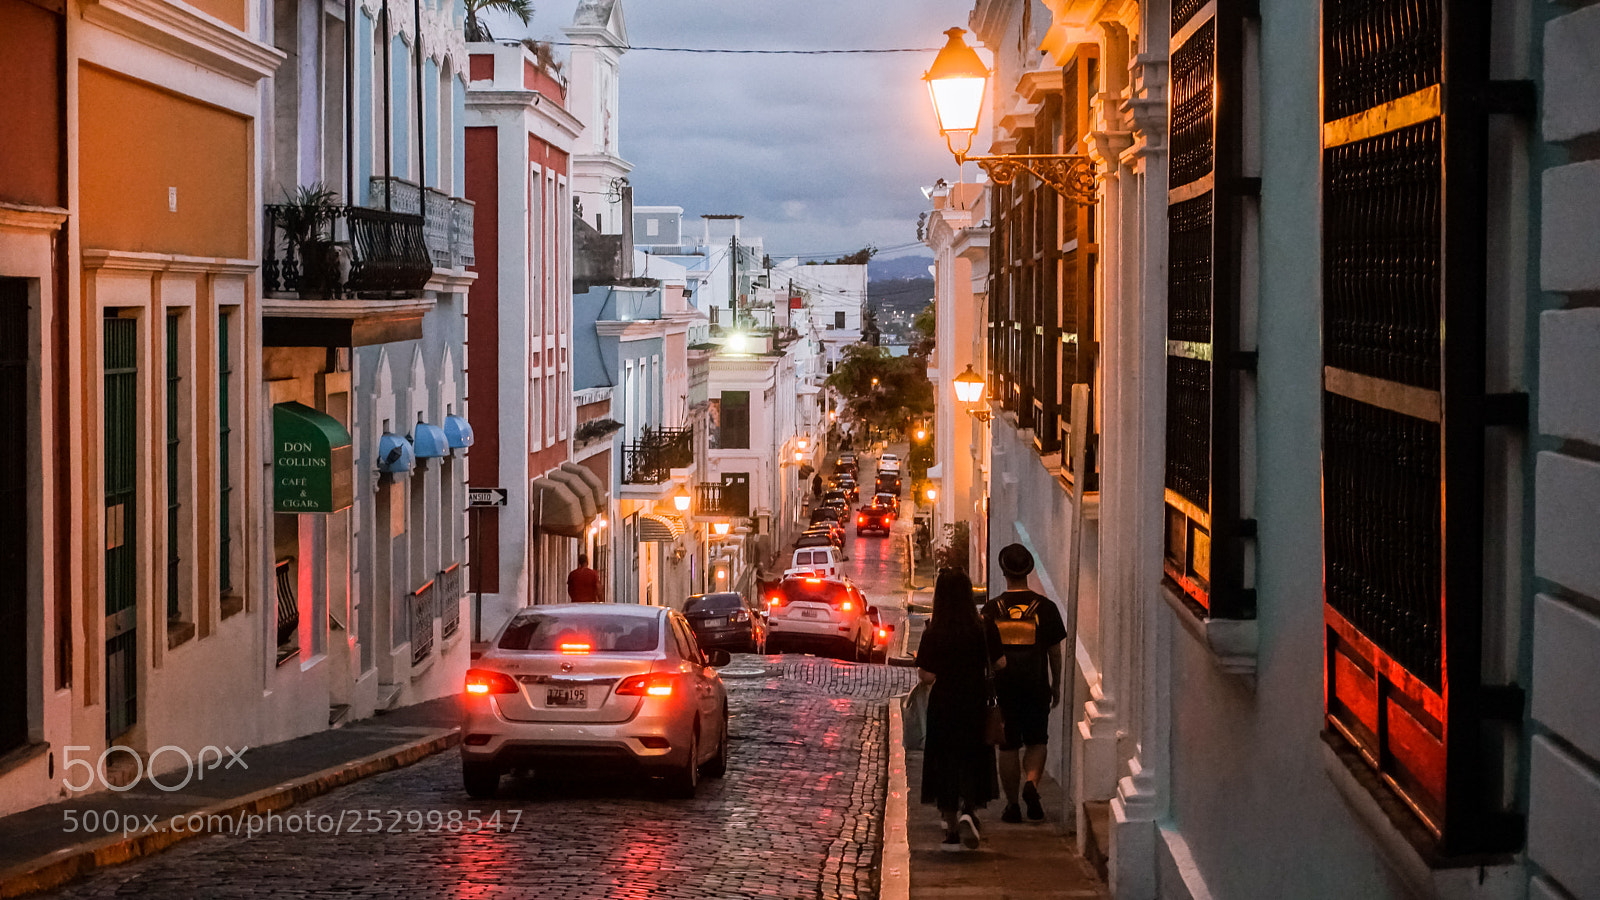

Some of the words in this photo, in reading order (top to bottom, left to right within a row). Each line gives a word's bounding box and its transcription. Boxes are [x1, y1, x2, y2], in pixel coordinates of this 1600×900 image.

[284, 442, 312, 452] DON
[278, 457, 326, 467] COLLINS
[300, 489, 307, 497] &
[282, 499, 319, 508] CIGARS
[569, 689, 585, 700] 195
